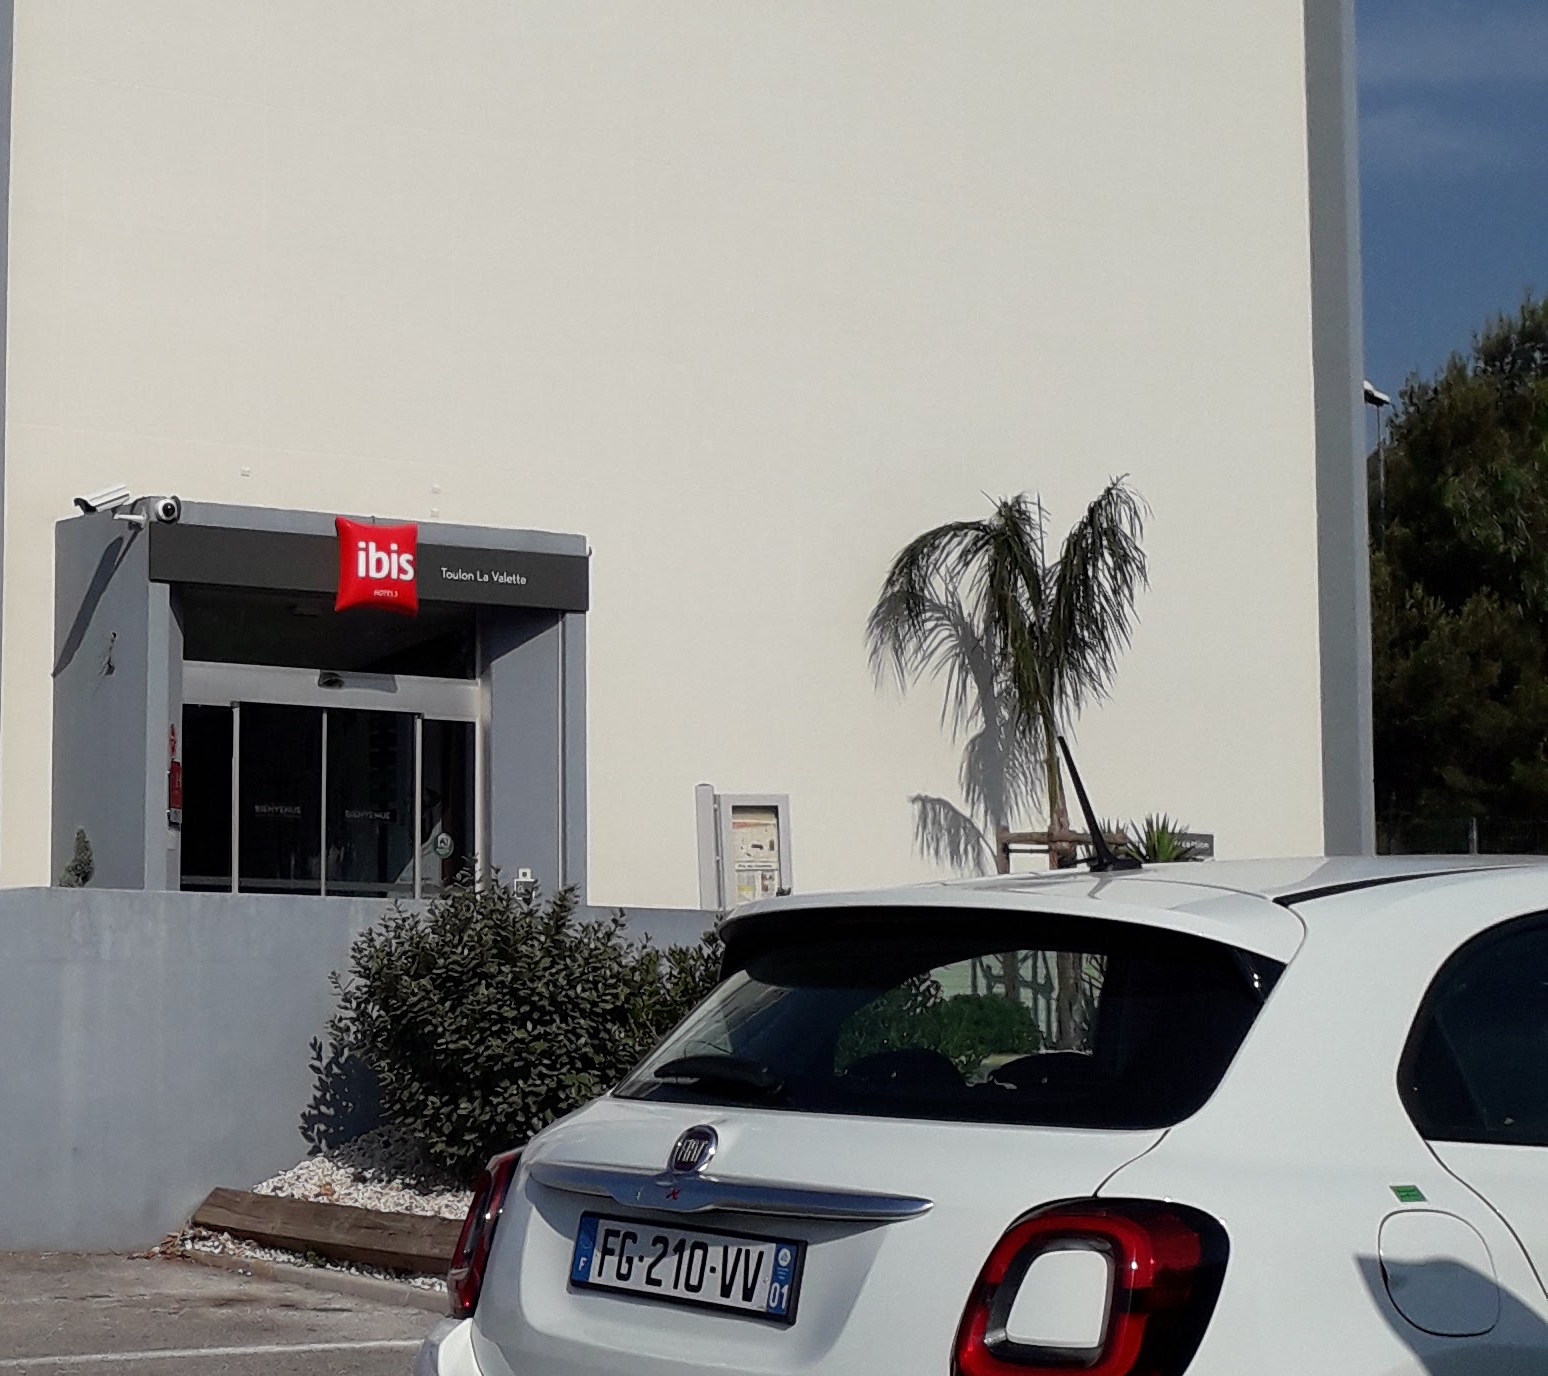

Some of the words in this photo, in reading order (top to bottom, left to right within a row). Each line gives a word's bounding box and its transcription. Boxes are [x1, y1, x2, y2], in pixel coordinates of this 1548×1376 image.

[357, 541, 415, 581] ibis
[441, 567, 474, 582] Toulon
[477, 570, 489, 583] La
[491, 571, 527, 585] Valette
[676, 1138, 708, 1162] FIAT
[578, 1257, 588, 1271] F
[597, 1228, 765, 1303] FG-210-VV
[768, 1282, 789, 1309] 01
